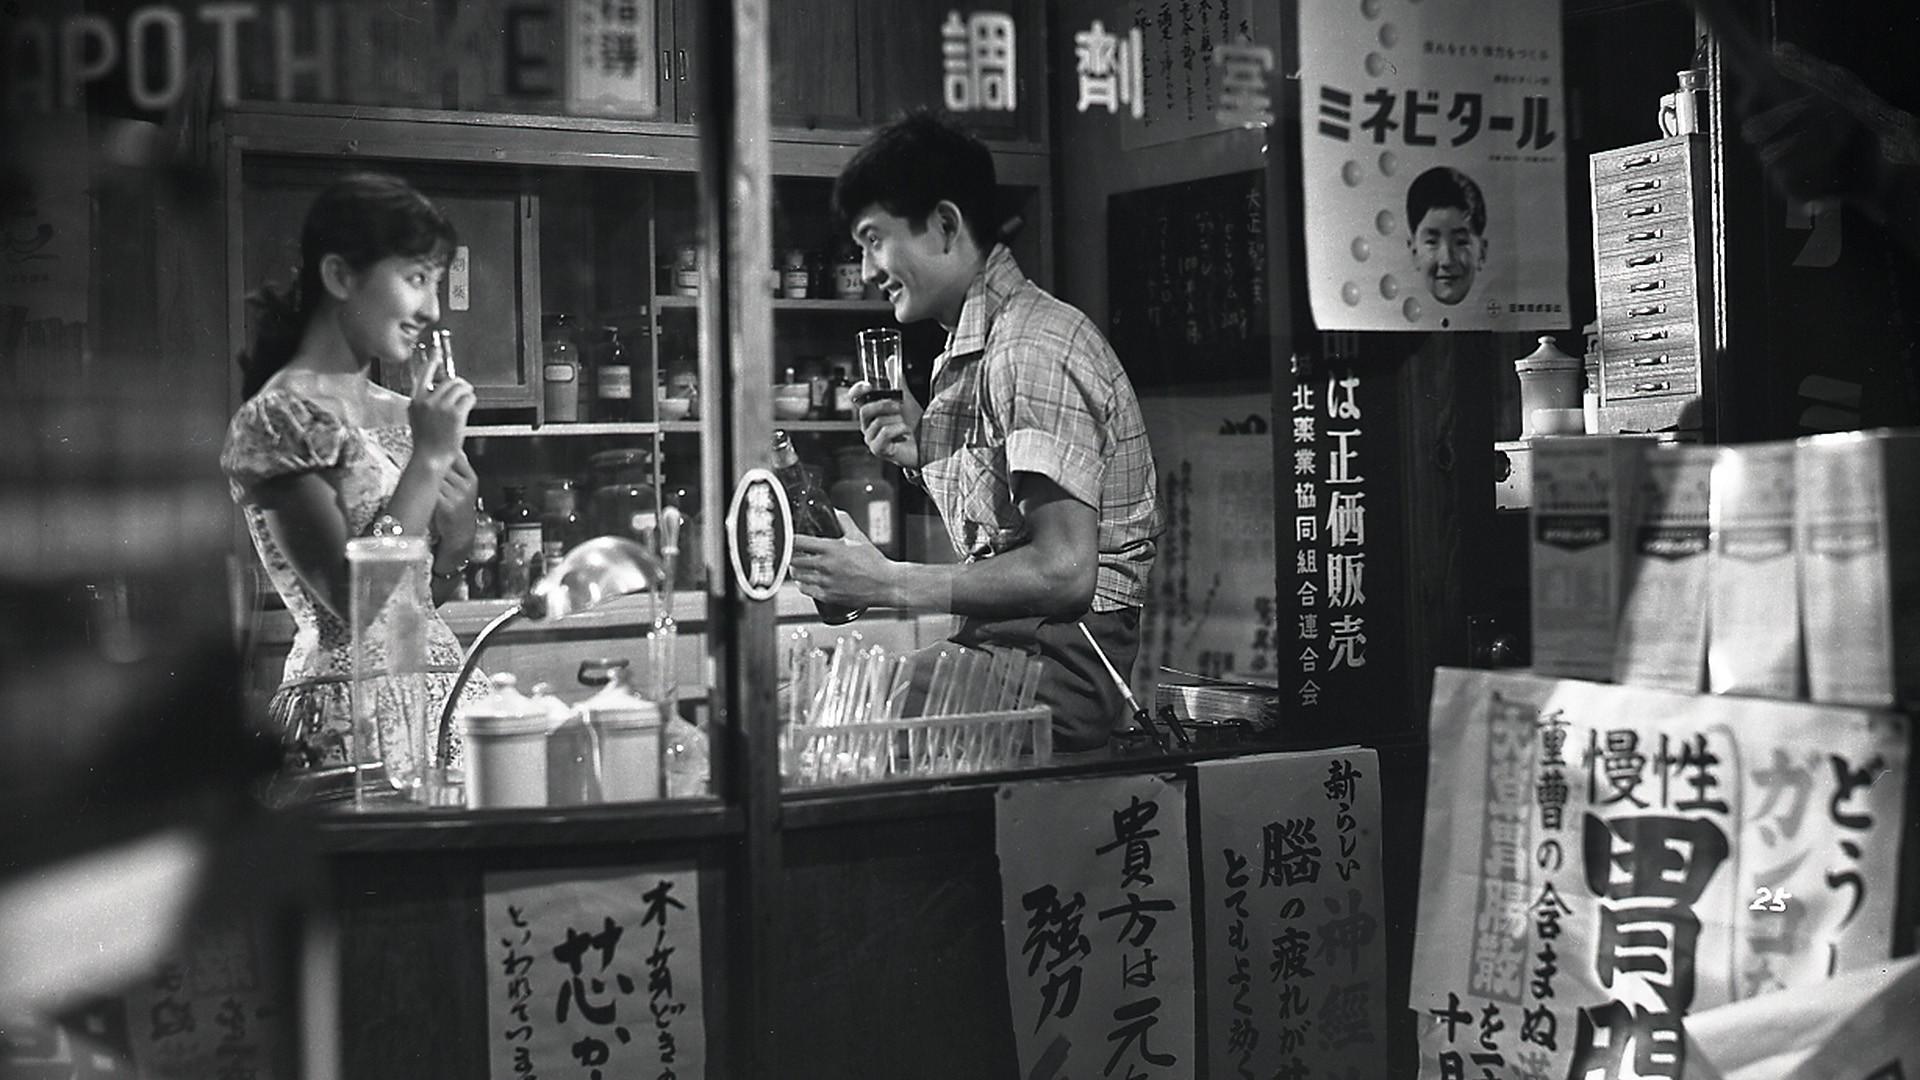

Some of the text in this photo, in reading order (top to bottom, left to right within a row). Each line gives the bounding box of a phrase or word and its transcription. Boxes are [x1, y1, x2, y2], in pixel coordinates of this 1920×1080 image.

[10, 4, 557, 110] APOTHE
[1317, 86, 1558, 152] ミネビタール
[1290, 353, 1321, 707] 北薬業協同組合連合会
[1582, 727, 1729, 814] 慢性
[501, 905, 536, 1080] といわれてつま
[553, 916, 636, 1080] 芯か
[1096, 795, 1177, 1080] 貴方は元
